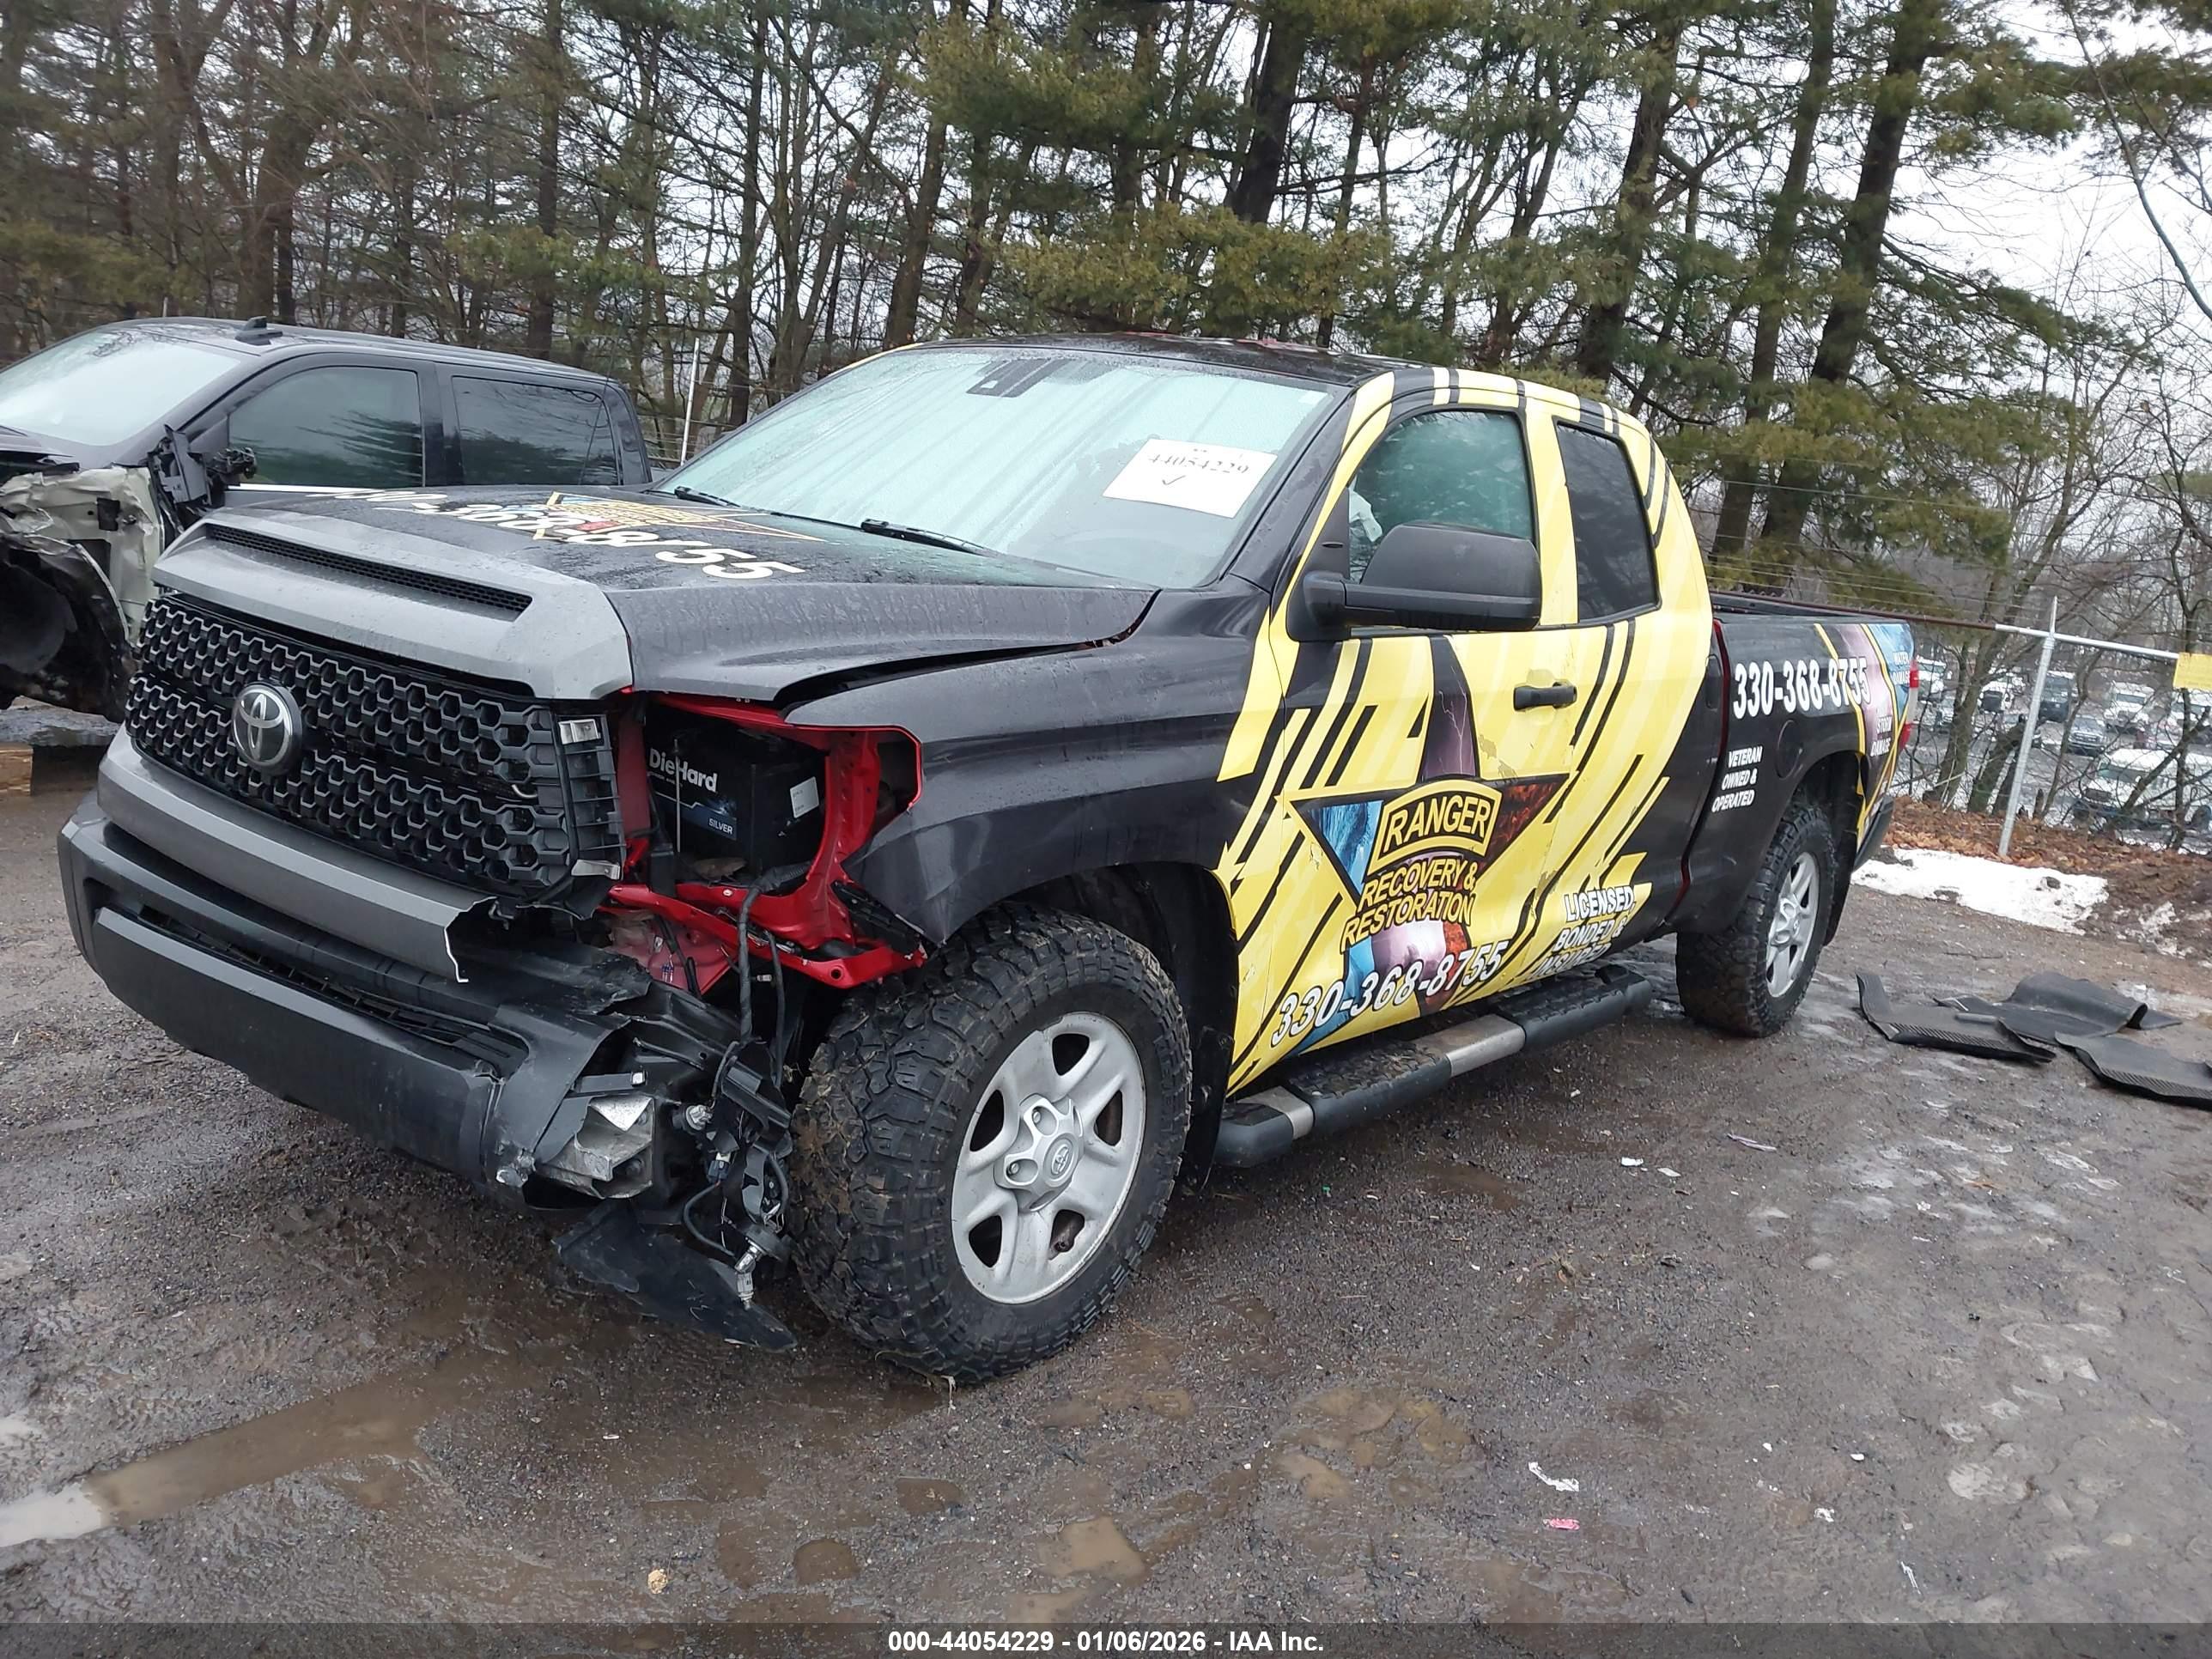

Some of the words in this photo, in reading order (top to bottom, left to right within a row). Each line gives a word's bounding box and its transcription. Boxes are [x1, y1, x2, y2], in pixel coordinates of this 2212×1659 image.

[1733, 656, 1871, 720] 330-368-8755
[649, 747, 718, 793] DieHard
[1729, 745, 1763, 768] VETERAN
[1721, 770, 1749, 791] OWNED
[1748, 769, 1758, 785] &
[1711, 789, 1755, 813] OPERATED
[708, 817, 733, 835] SILVER
[1383, 795, 1492, 854] RANGER
[1357, 858, 1468, 913] RECOVERY
[1463, 860, 1479, 890] &
[1564, 885, 1637, 922] LICENSED,
[1340, 891, 1475, 952] RESTORATION
[1552, 919, 1615, 952] BONDED
[1611, 915, 1628, 939] &
[1271, 940, 1510, 1047] 330-368-8755
